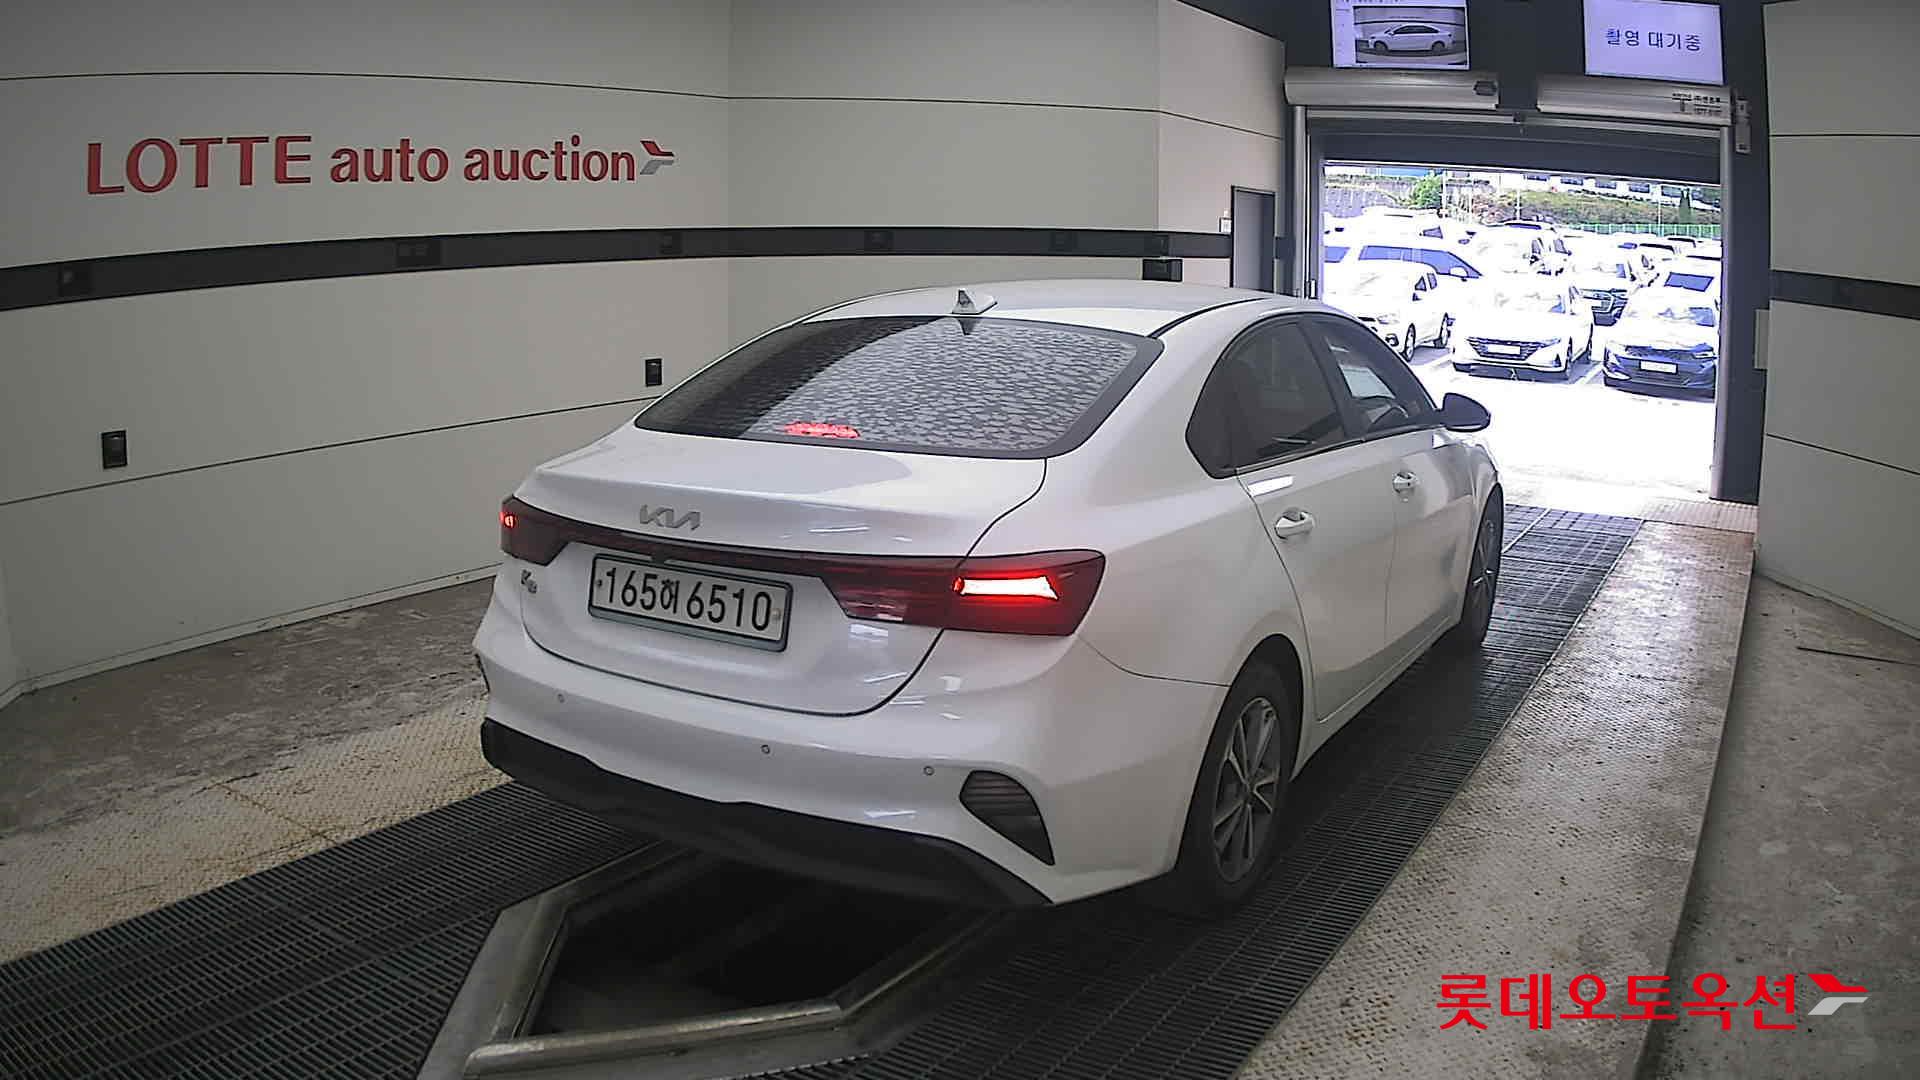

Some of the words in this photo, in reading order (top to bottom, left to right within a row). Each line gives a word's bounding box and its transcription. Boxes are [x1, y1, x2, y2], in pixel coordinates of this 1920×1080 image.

[1648, 31, 1701, 52] 대기중
[87, 136, 312, 194] LOTTE
[330, 138, 449, 183] auto
[463, 135, 636, 182] auction
